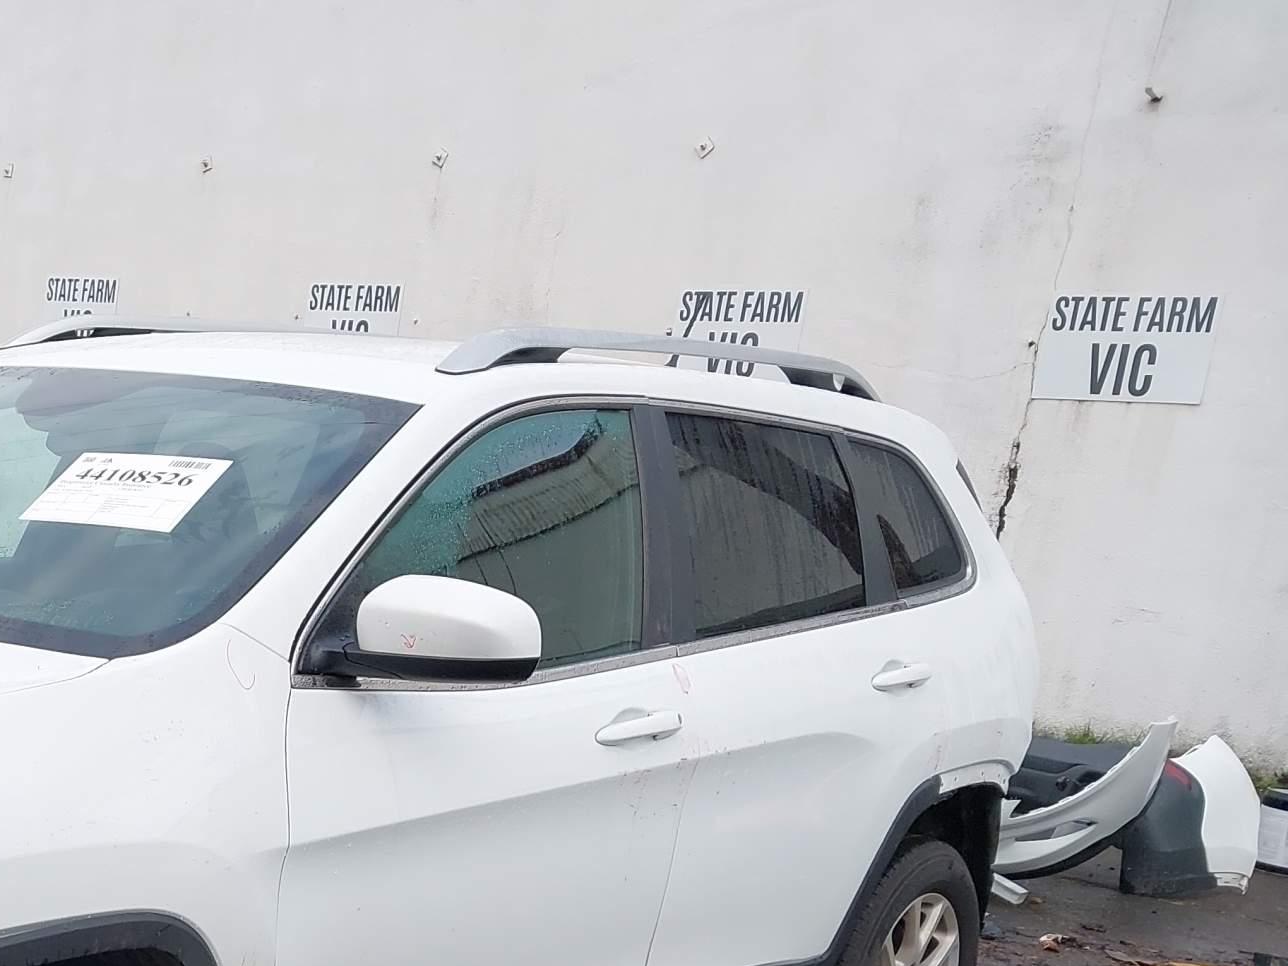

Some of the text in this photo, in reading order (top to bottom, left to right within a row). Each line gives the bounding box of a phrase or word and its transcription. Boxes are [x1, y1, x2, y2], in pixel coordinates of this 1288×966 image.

[46, 277, 117, 304] STATE FARM
[309, 284, 401, 313] STATE FARM
[679, 290, 804, 323] STATE FARM
[1051, 295, 1219, 333] STATE FARM
[1089, 342, 1158, 397] VIC
[75, 467, 200, 487] 44108526
